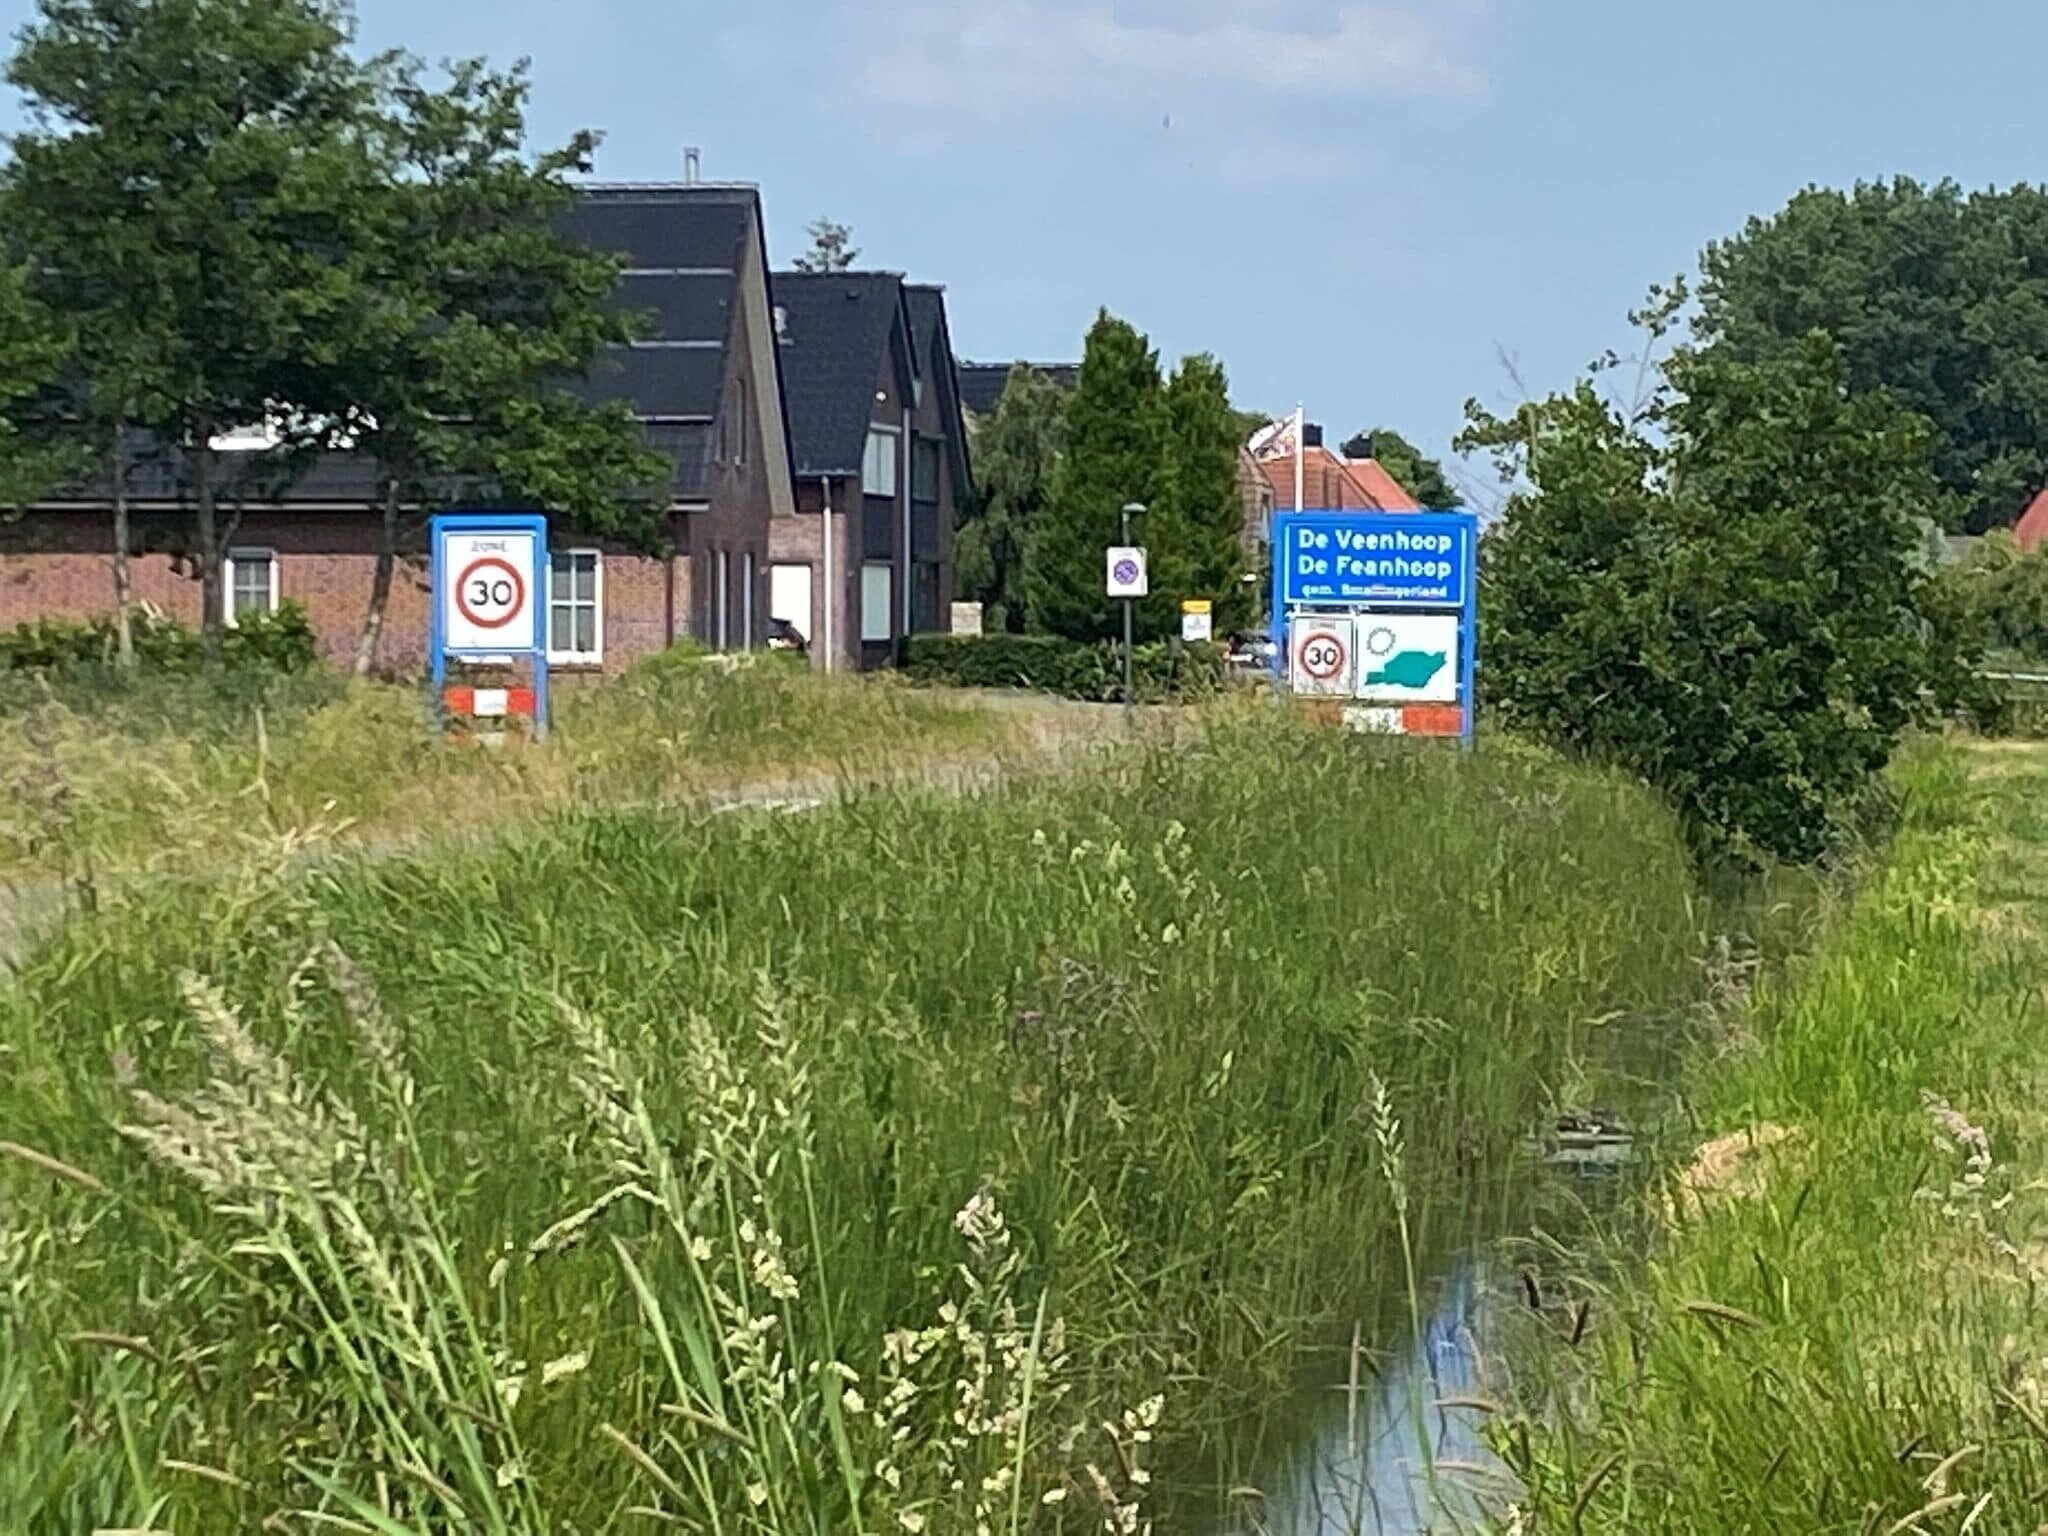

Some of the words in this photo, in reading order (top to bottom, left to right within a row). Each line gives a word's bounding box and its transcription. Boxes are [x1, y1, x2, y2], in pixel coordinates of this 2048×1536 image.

[1298, 529, 1328, 549] De
[1335, 529, 1452, 555] Veenhoop
[1298, 556, 1328, 575] De
[1337, 556, 1451, 581] Feanhoop
[470, 579, 512, 606] 30
[1341, 584, 1447, 599] Smagerland
[1309, 647, 1337, 666] 30
